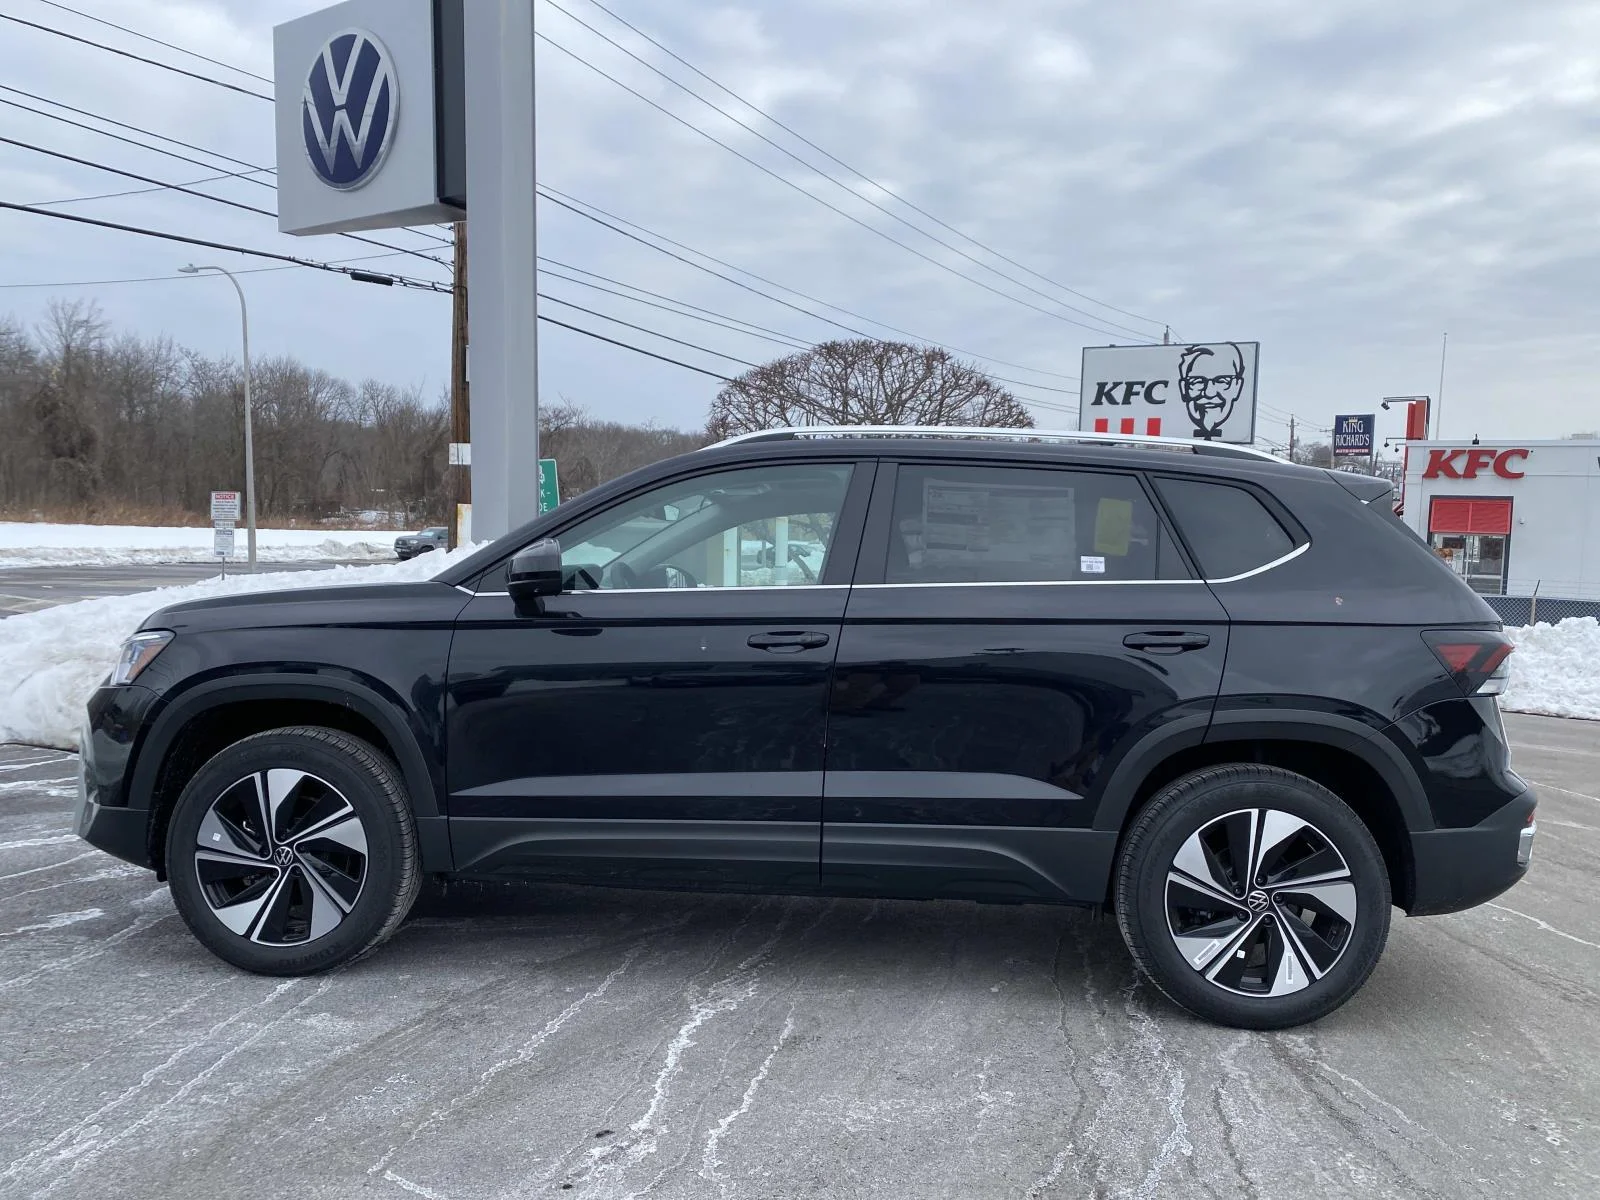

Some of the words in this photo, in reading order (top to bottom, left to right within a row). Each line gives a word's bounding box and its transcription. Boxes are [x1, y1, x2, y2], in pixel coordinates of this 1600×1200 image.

[303, 30, 395, 185] VW
[1091, 380, 1169, 405] KFC
[1342, 420, 1364, 433] KING
[1335, 434, 1370, 446] RICHARD'S
[1422, 449, 1529, 479] KFC
